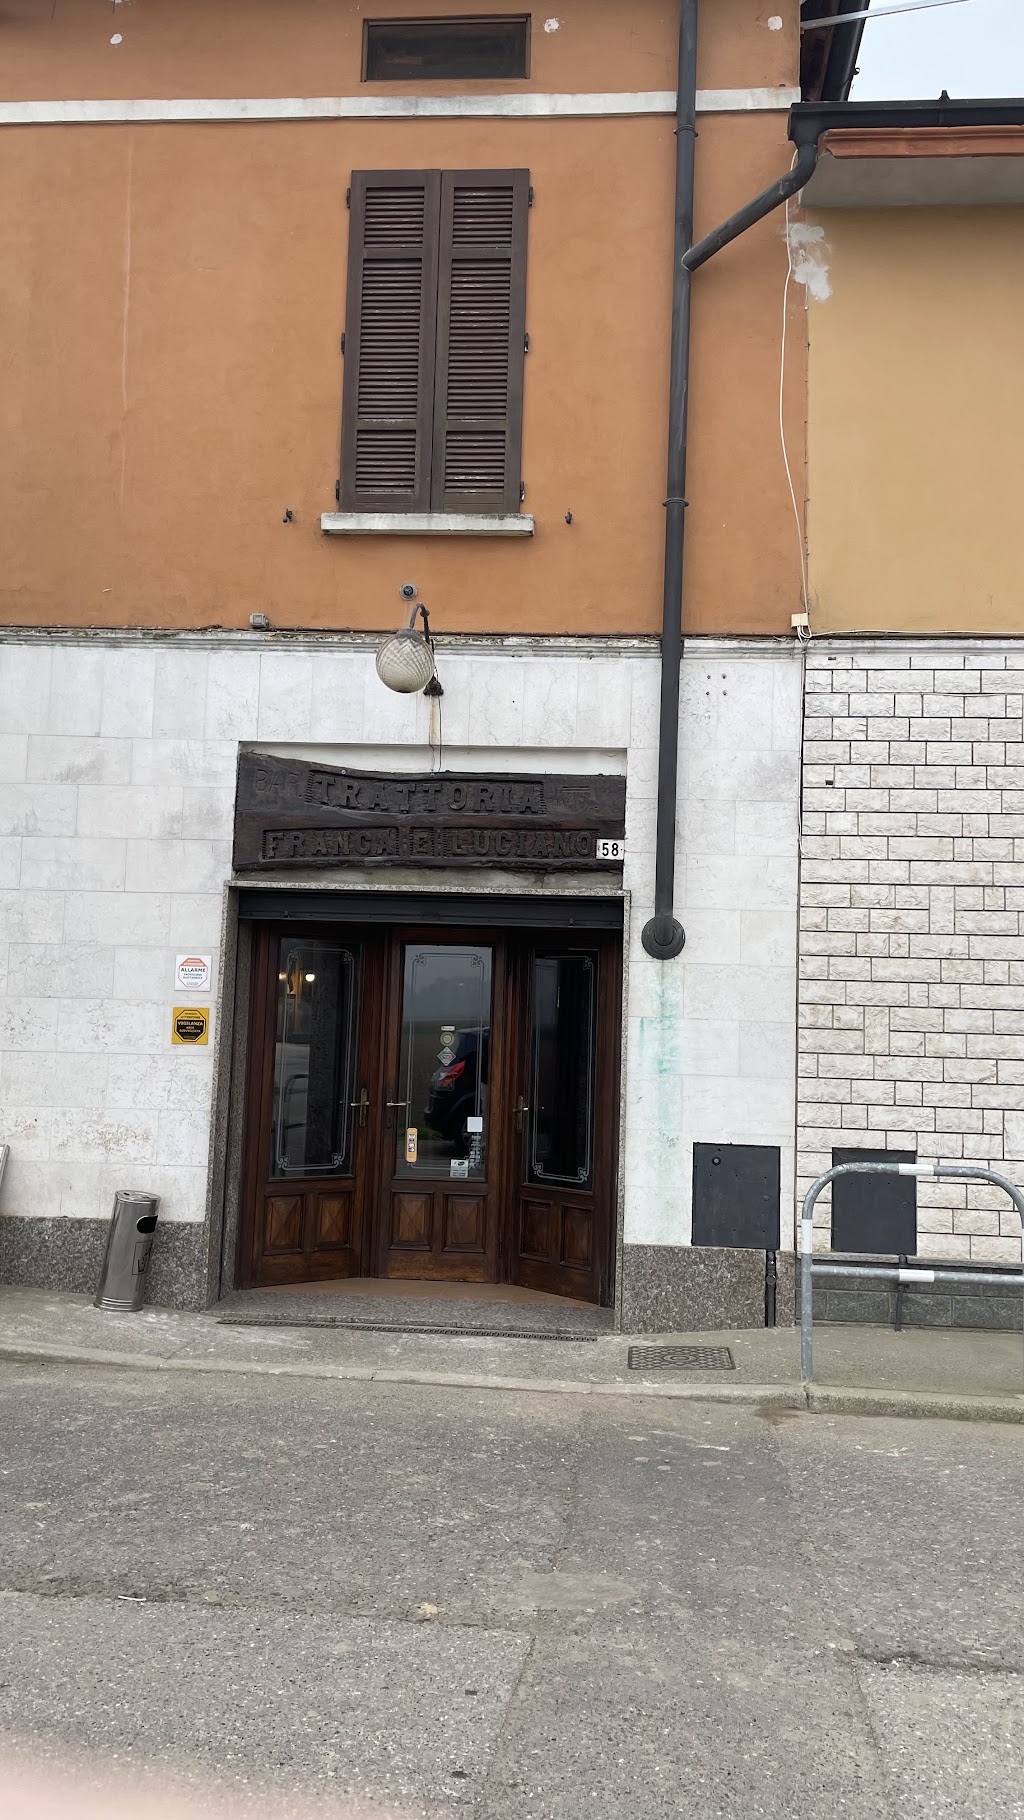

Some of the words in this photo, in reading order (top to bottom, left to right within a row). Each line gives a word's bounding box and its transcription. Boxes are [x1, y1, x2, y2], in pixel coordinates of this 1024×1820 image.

[314, 776, 540, 814] TRATTORIA
[267, 830, 397, 857] FRANCA
[415, 831, 430, 856] E
[450, 830, 593, 858] LUCIANO
[601, 842, 620, 857] 58
